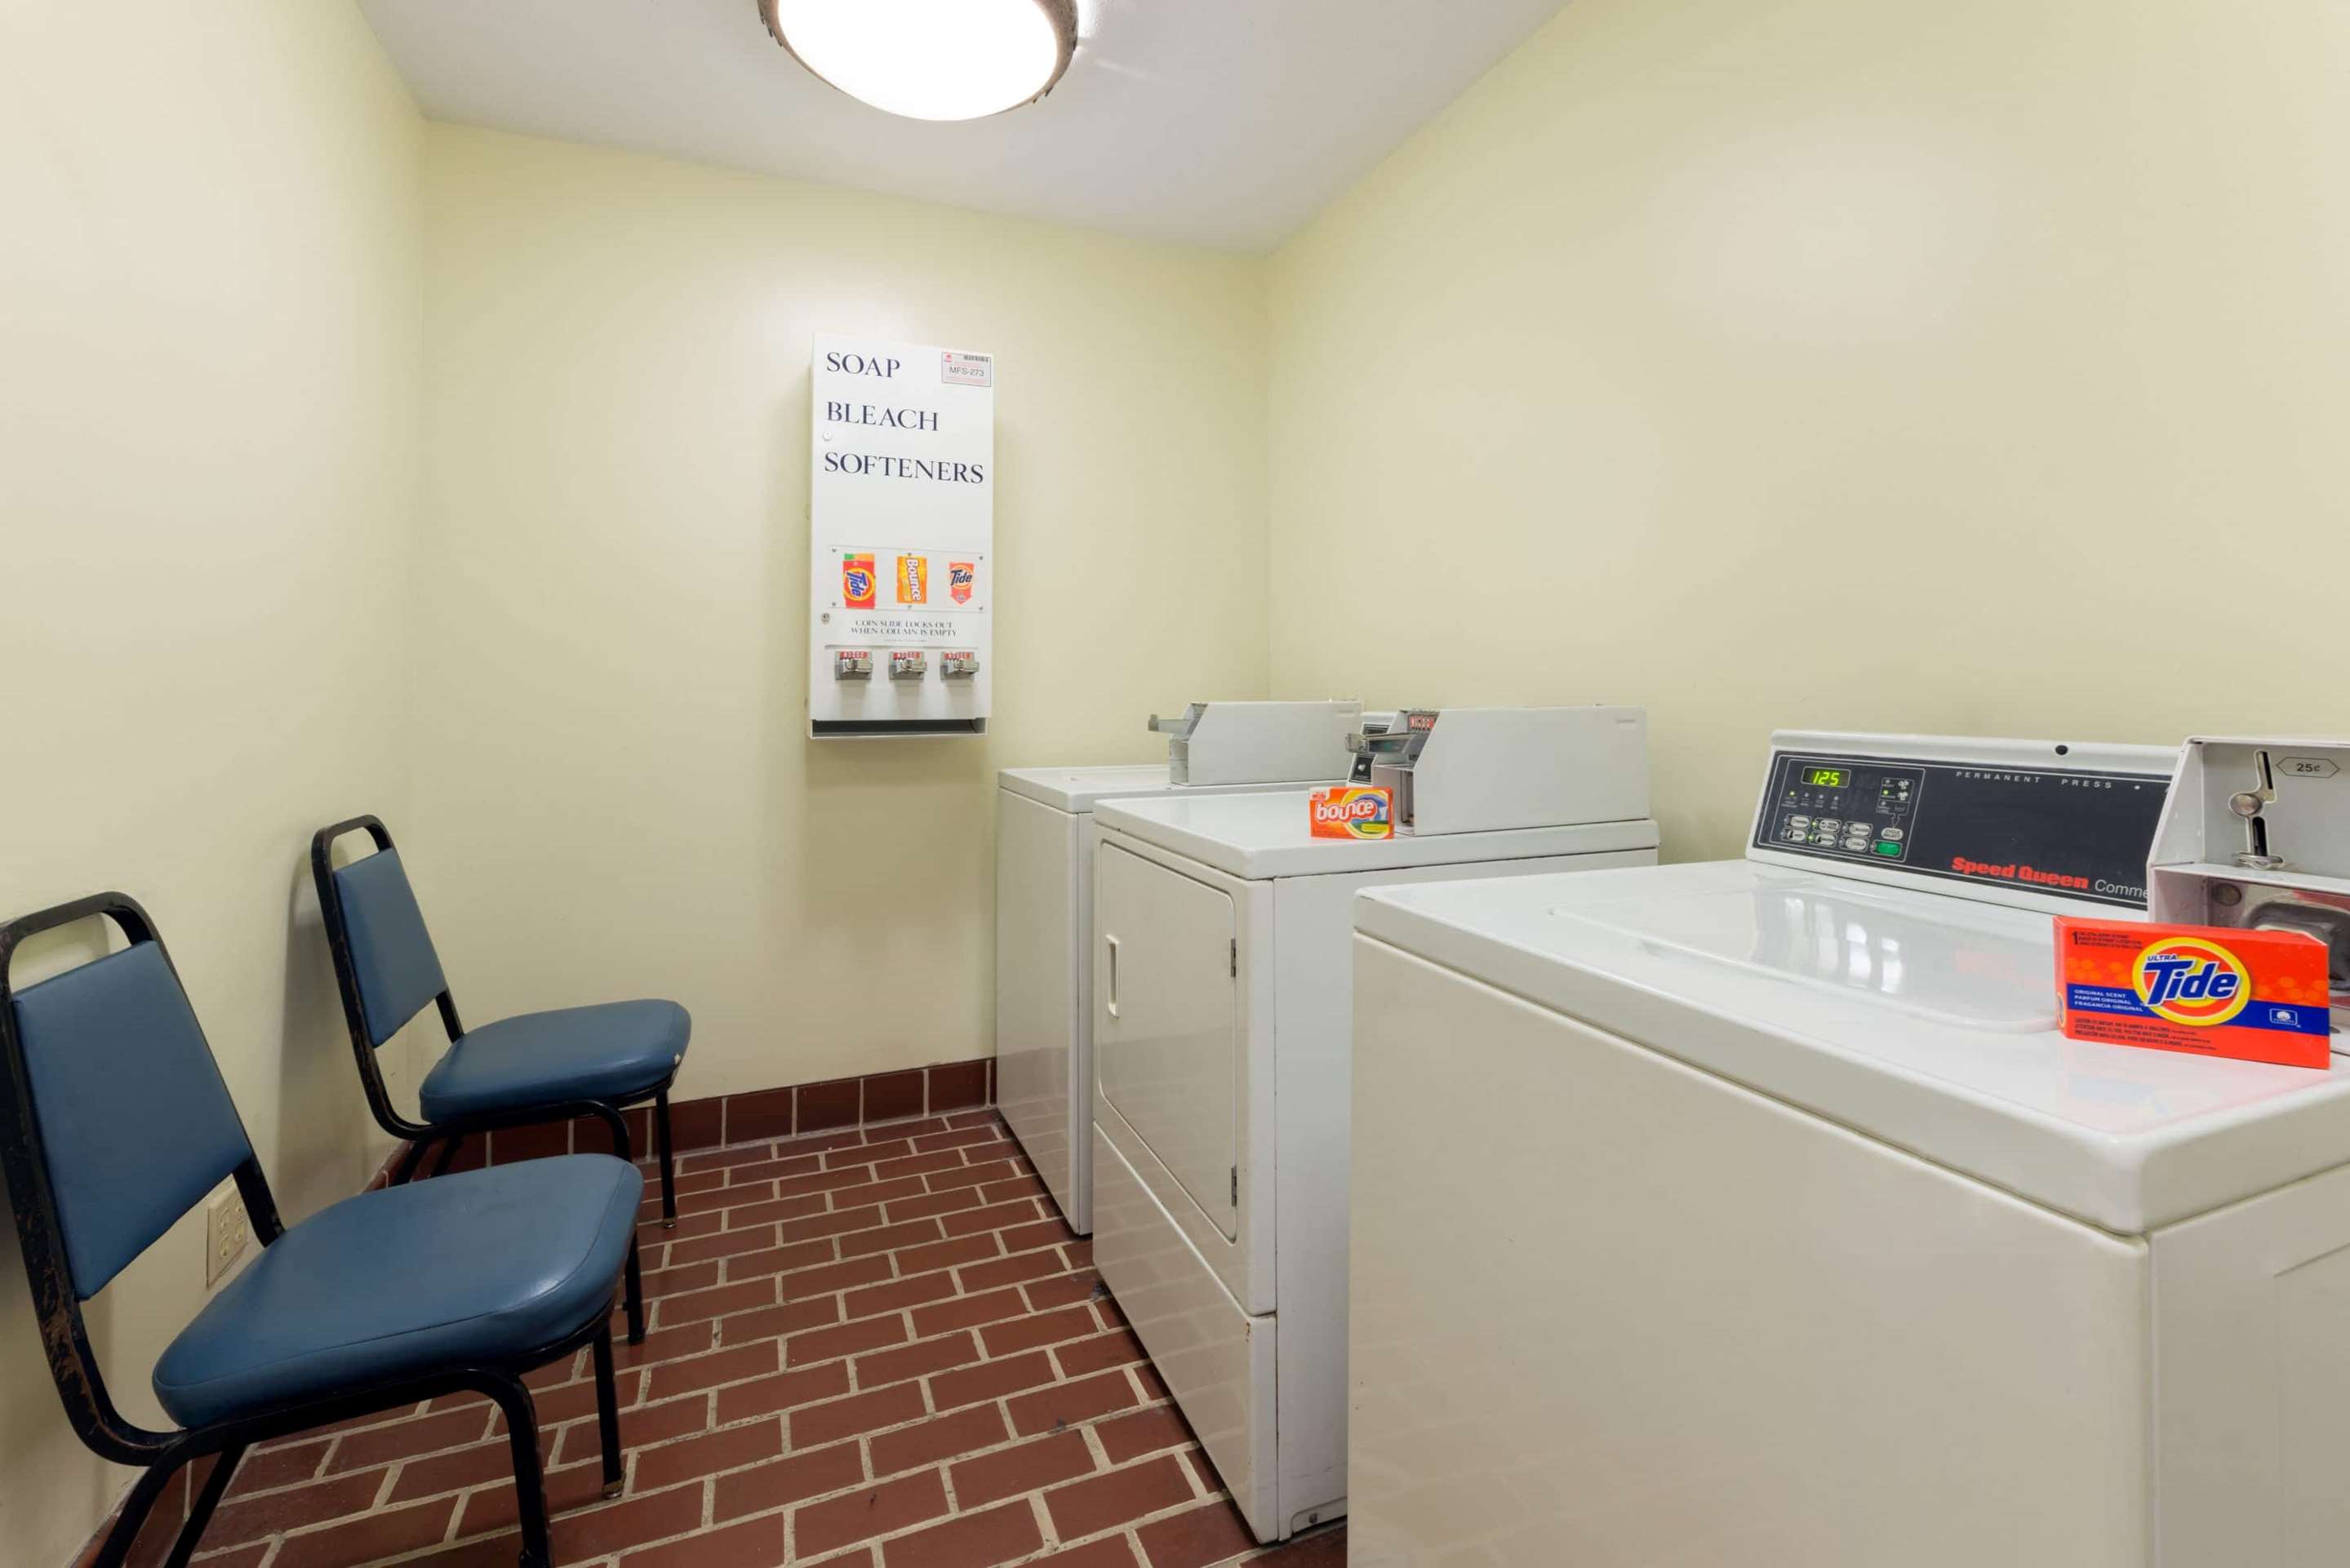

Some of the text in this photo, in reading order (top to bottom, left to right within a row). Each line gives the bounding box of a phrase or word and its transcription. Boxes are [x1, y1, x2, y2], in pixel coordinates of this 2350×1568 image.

[826, 352, 900, 378] SOAP
[949, 366, 984, 377] MFS-273
[827, 401, 939, 432] BLEACH
[824, 451, 984, 484] SOFTENERS
[846, 571, 868, 597] Tide
[950, 569, 973, 586] Tide
[905, 620, 933, 629] LOCKS
[1813, 771, 1840, 784] 125
[1957, 771, 2112, 788] PERMANENT PRESS
[1317, 801, 1375, 820] bounce
[1952, 857, 2016, 878] Speed
[2019, 866, 2090, 889] Queen
[2143, 960, 2239, 1006] Tide
[2074, 1001, 2111, 1009] FRAGANCIA
